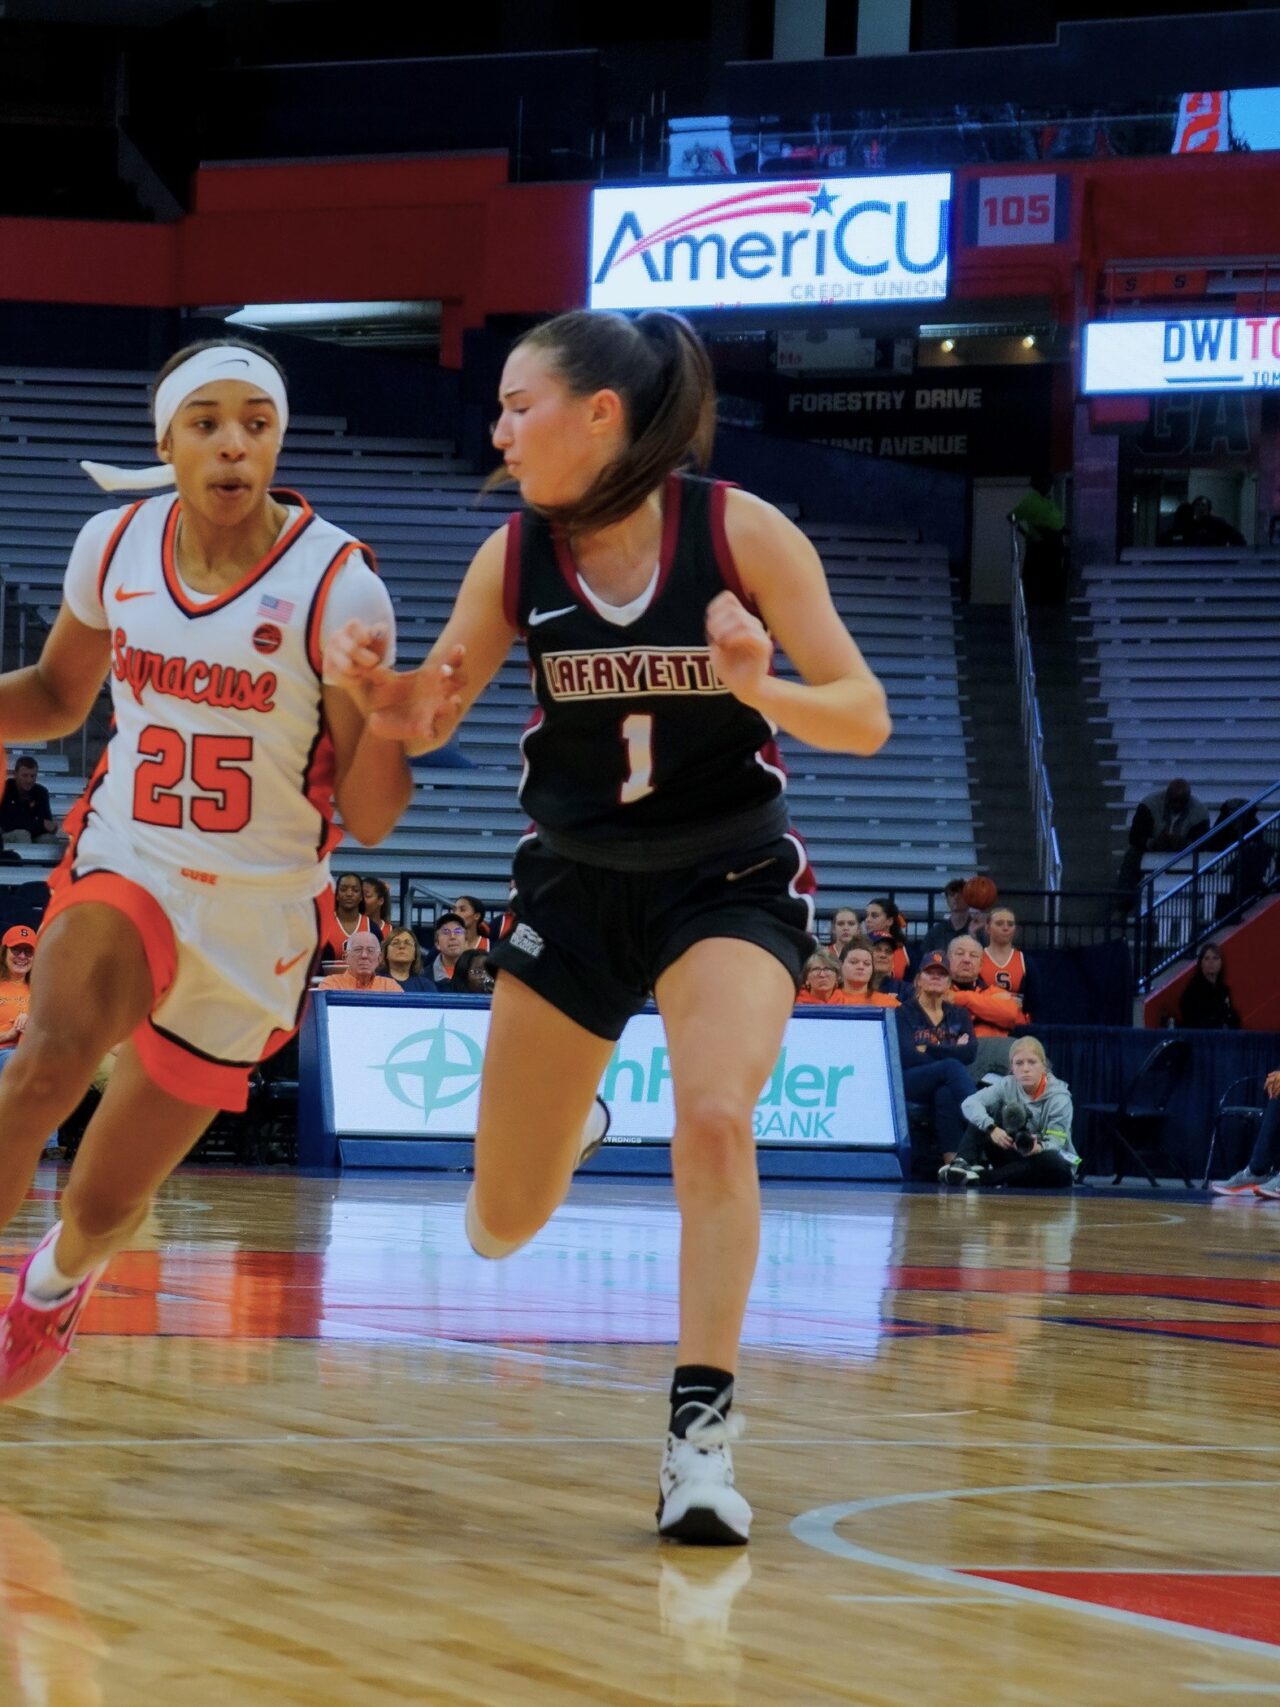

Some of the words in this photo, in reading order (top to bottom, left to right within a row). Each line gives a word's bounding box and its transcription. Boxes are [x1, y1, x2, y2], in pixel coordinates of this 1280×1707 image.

[984, 194, 1050, 227] 105
[594, 199, 949, 284] AmeriCU
[791, 283, 863, 299] CREDIT
[873, 279, 947, 297] UNION
[789, 390, 906, 412] FORESTRY
[915, 388, 982, 409] DRIVE
[879, 435, 968, 456] AVENUE
[113, 627, 276, 712] Syracuse
[545, 653, 729, 695] LAFAYETT
[619, 712, 656, 804] 1
[133, 724, 253, 833] 25
[603, 1136, 641, 1144] TRONICS
